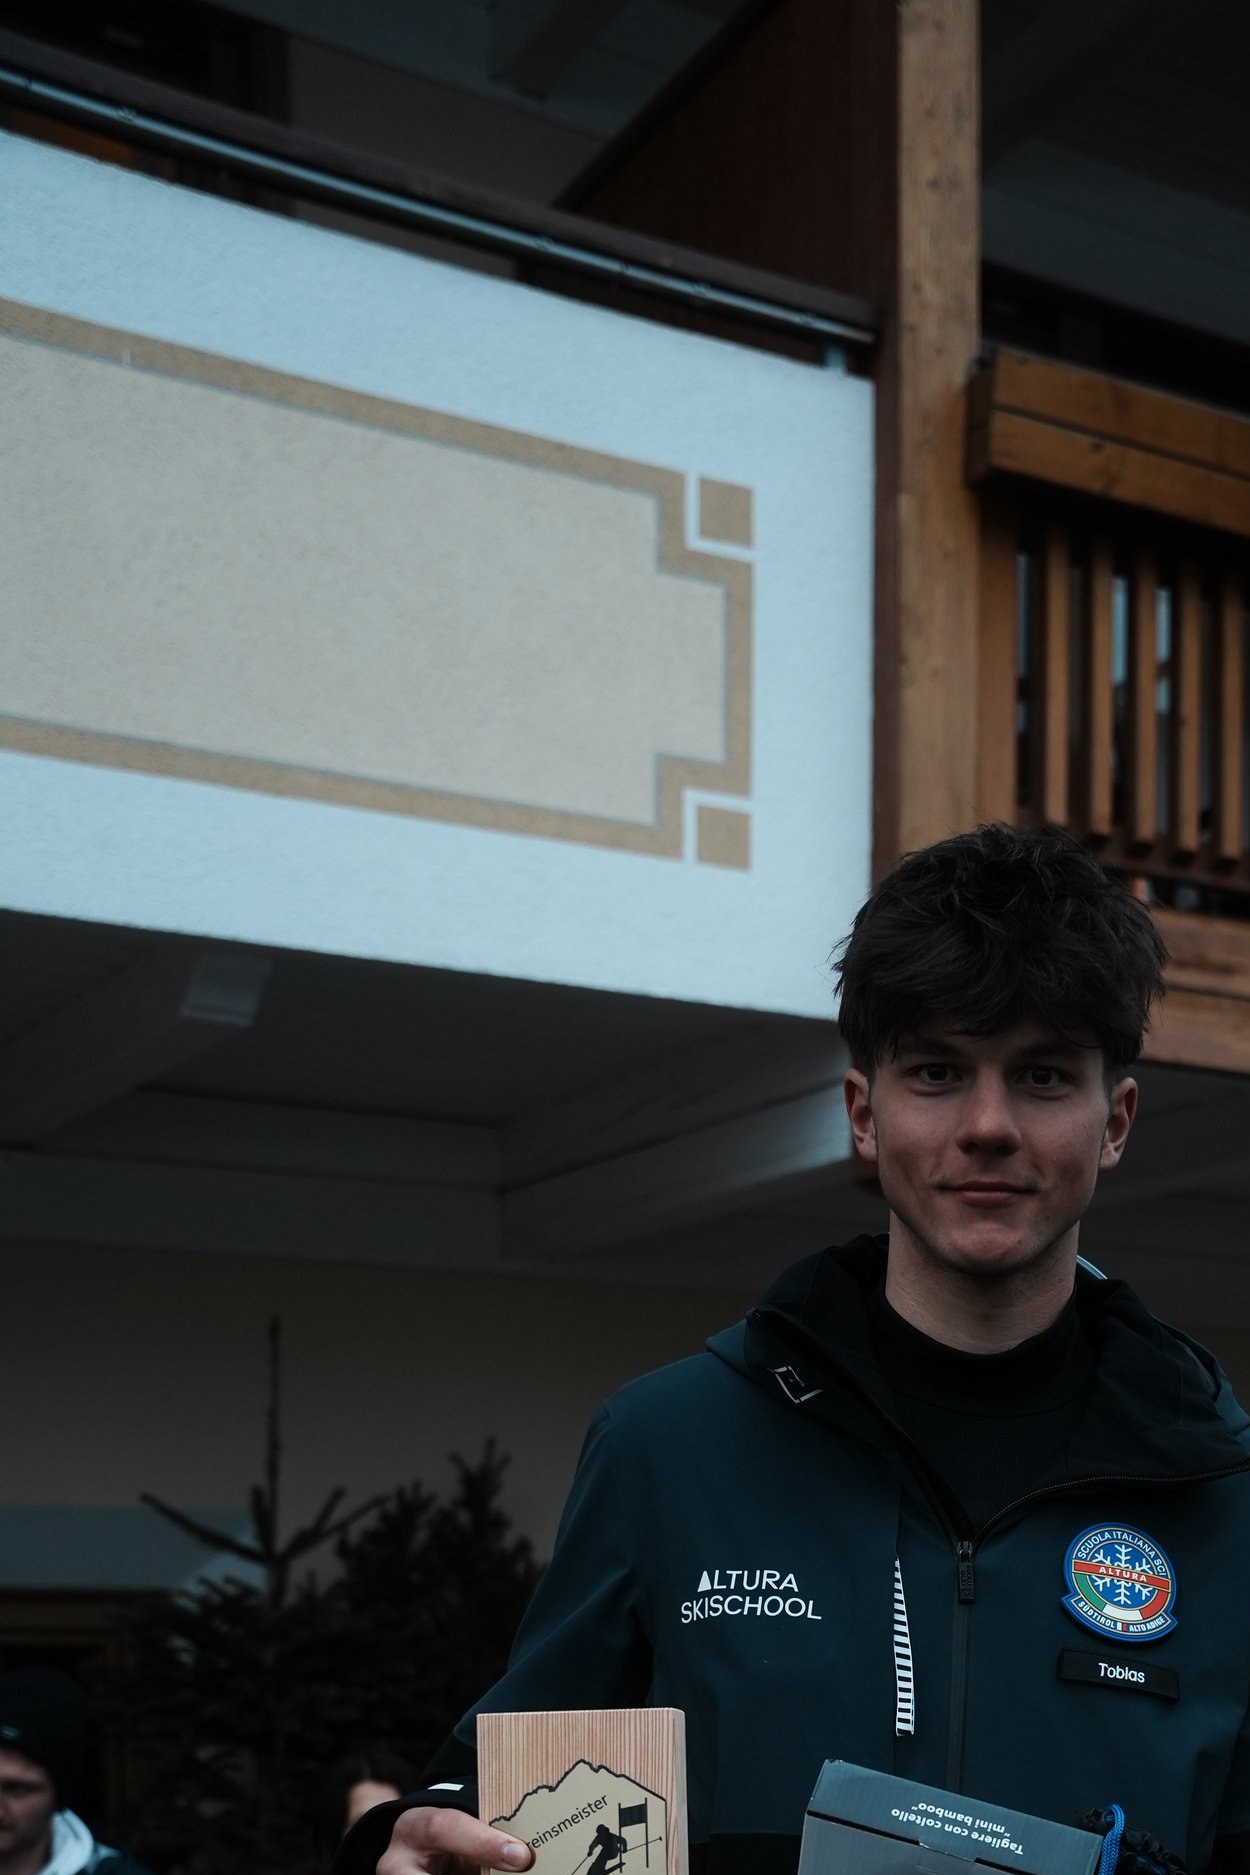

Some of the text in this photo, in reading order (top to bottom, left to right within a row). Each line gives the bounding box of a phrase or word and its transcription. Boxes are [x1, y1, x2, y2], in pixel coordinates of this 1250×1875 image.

[1078, 1531, 1167, 1576] SCUOLA ITALIANA SCI
[697, 1569, 799, 1593] ALTURA
[1099, 1566, 1147, 1583] ALTURA
[681, 1595, 822, 1624] SKISCHOOL
[1078, 1601, 1166, 1632] SÜDTIROL ALTO ADIGE
[1098, 1662, 1146, 1684] Tobias
[526, 1795, 609, 1849] reinsmeister
[891, 1808, 1024, 1855] Tagliere con coltello
